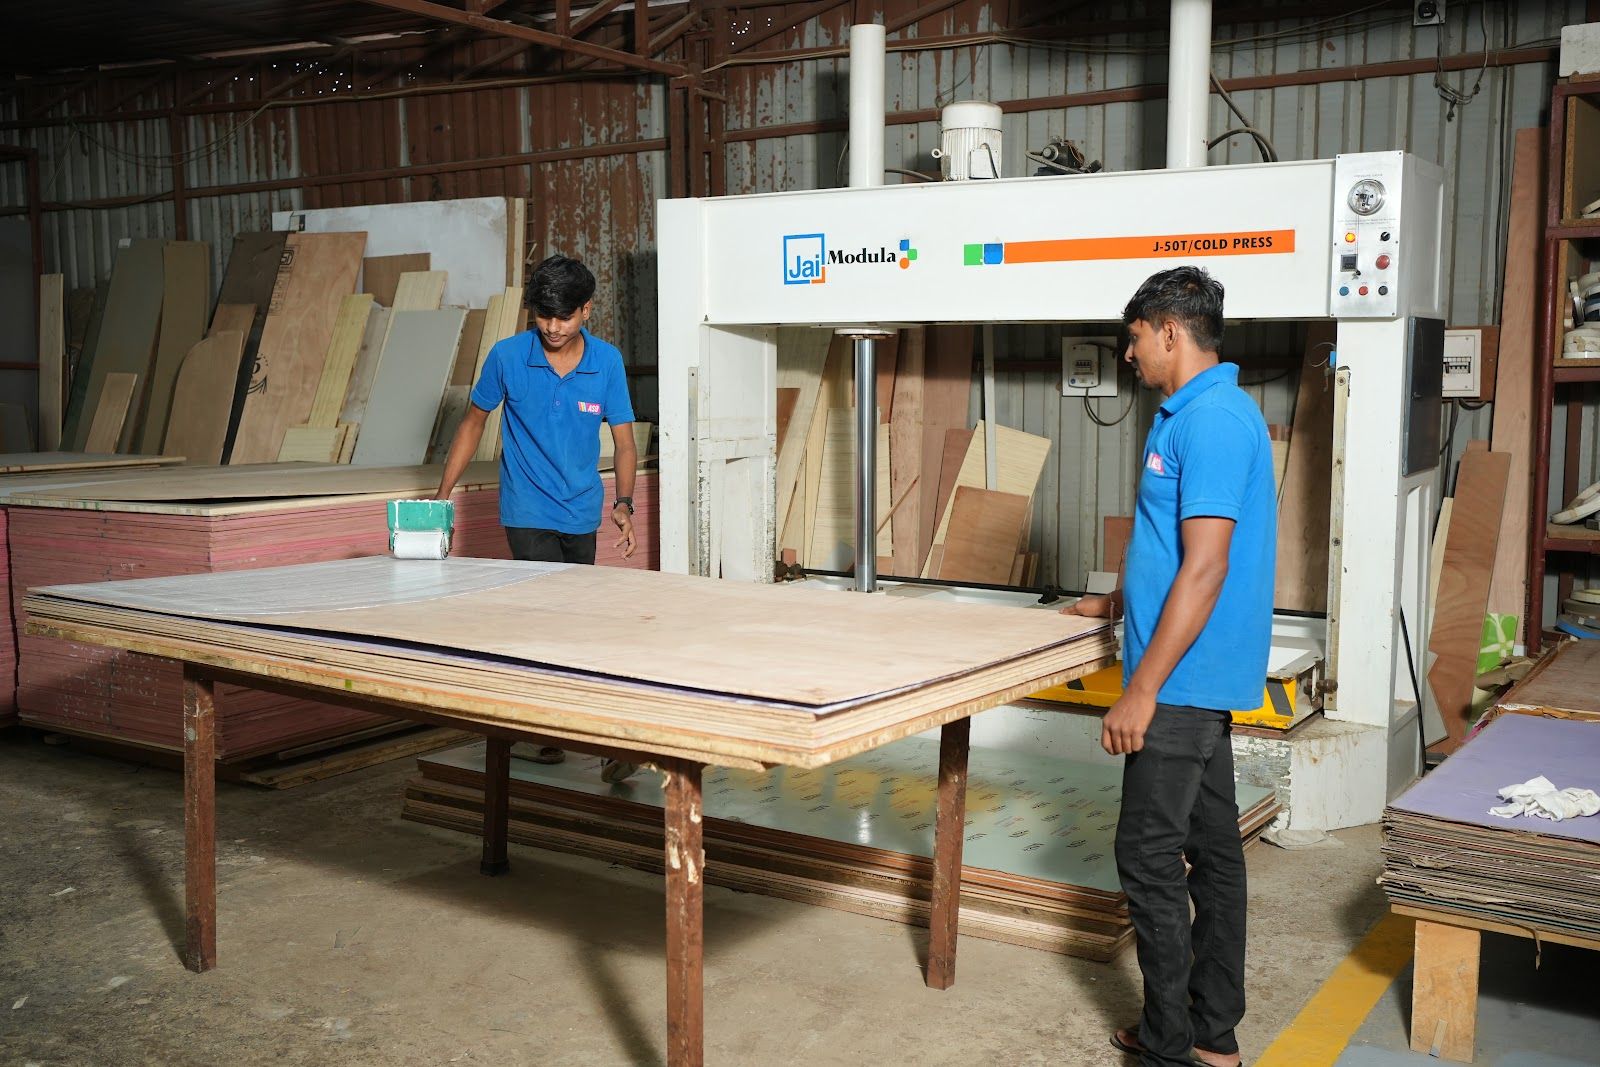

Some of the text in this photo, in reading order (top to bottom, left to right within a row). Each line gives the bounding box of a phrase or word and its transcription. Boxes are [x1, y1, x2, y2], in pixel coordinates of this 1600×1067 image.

[1153, 236, 1273, 254] J-50T/COLD PRESS
[789, 247, 896, 279] Jai Modula
